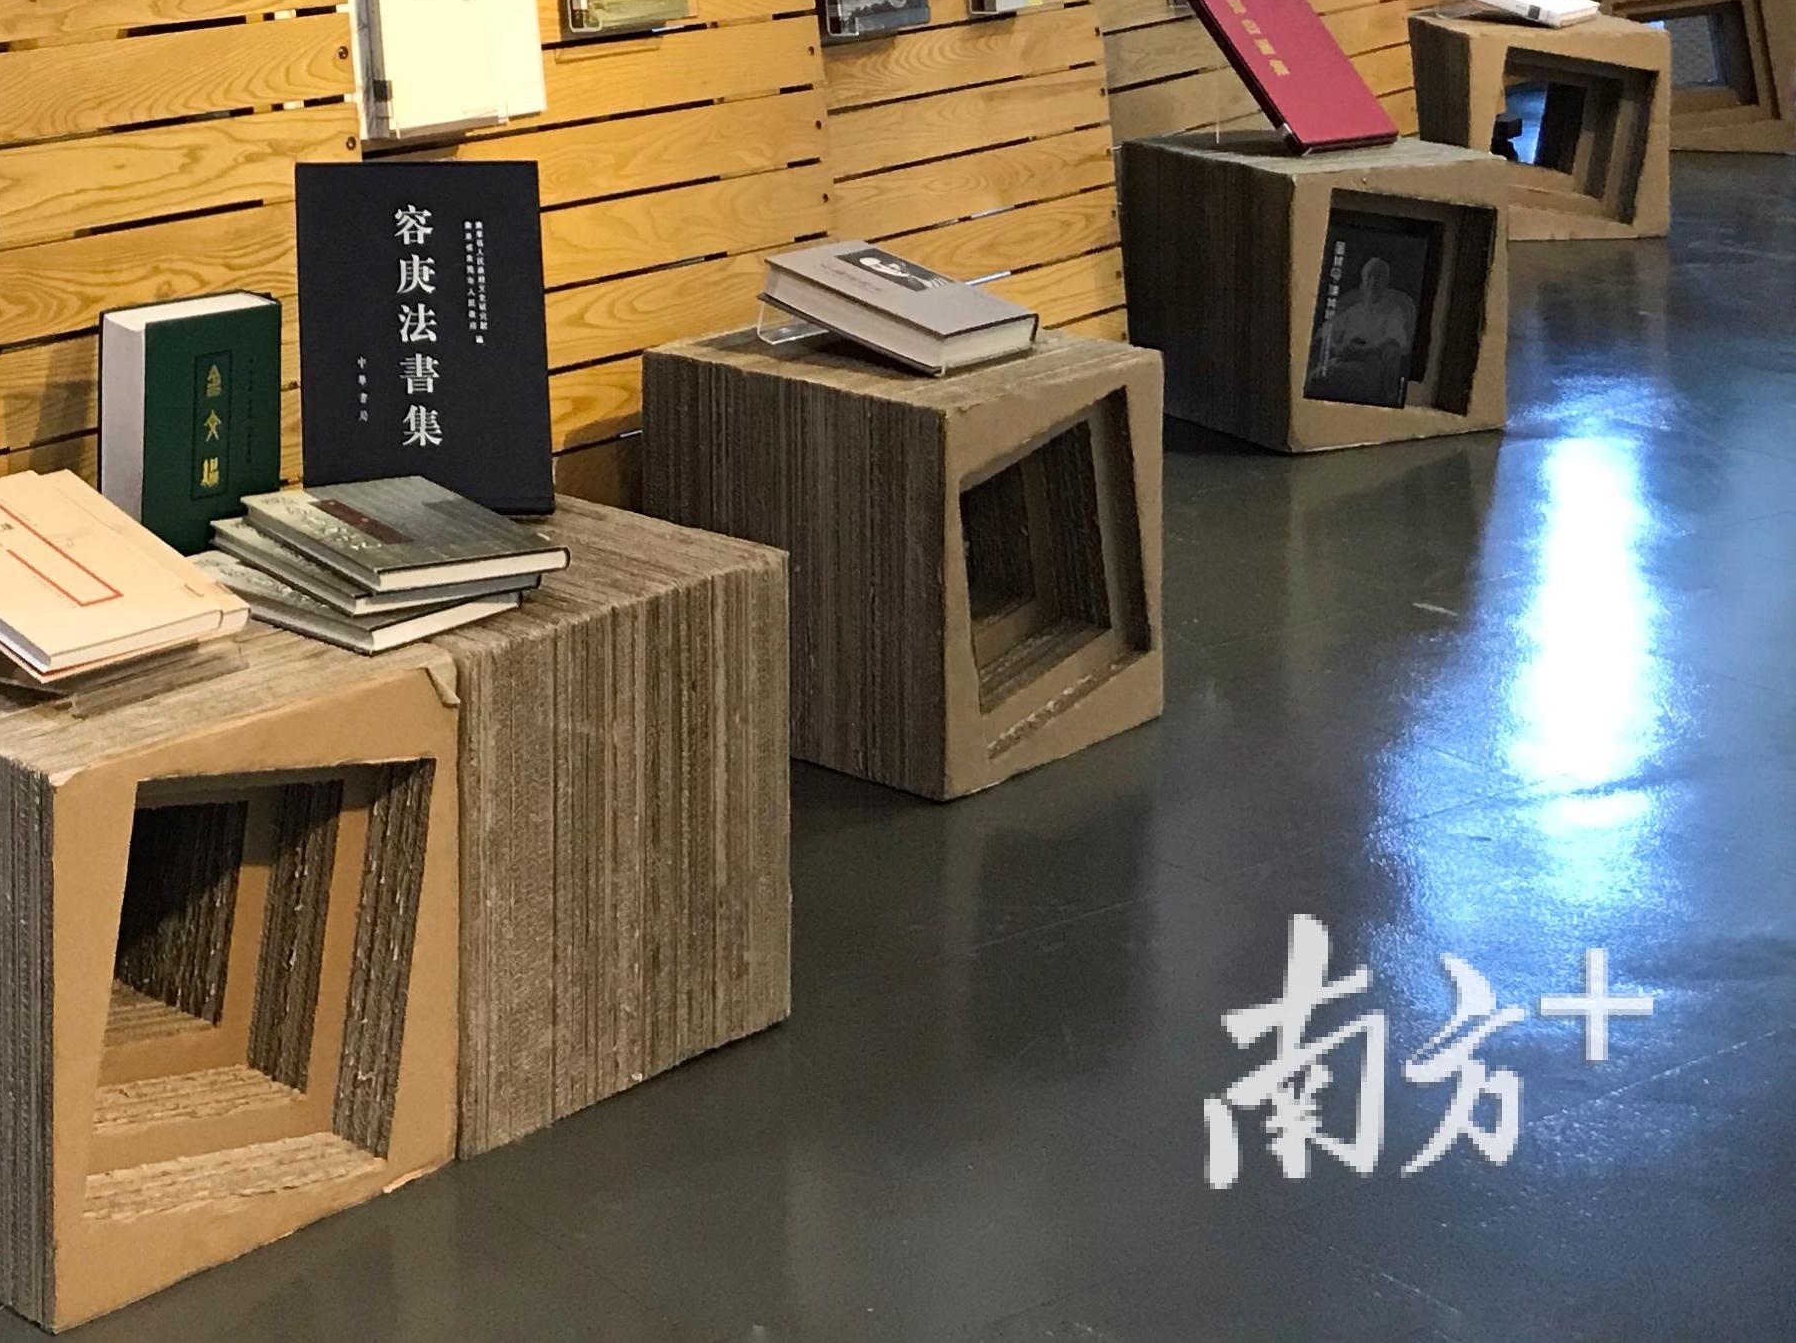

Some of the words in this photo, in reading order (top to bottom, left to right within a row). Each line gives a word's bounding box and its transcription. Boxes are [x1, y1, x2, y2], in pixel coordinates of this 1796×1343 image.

[393, 204, 444, 447] 容庚法書集
